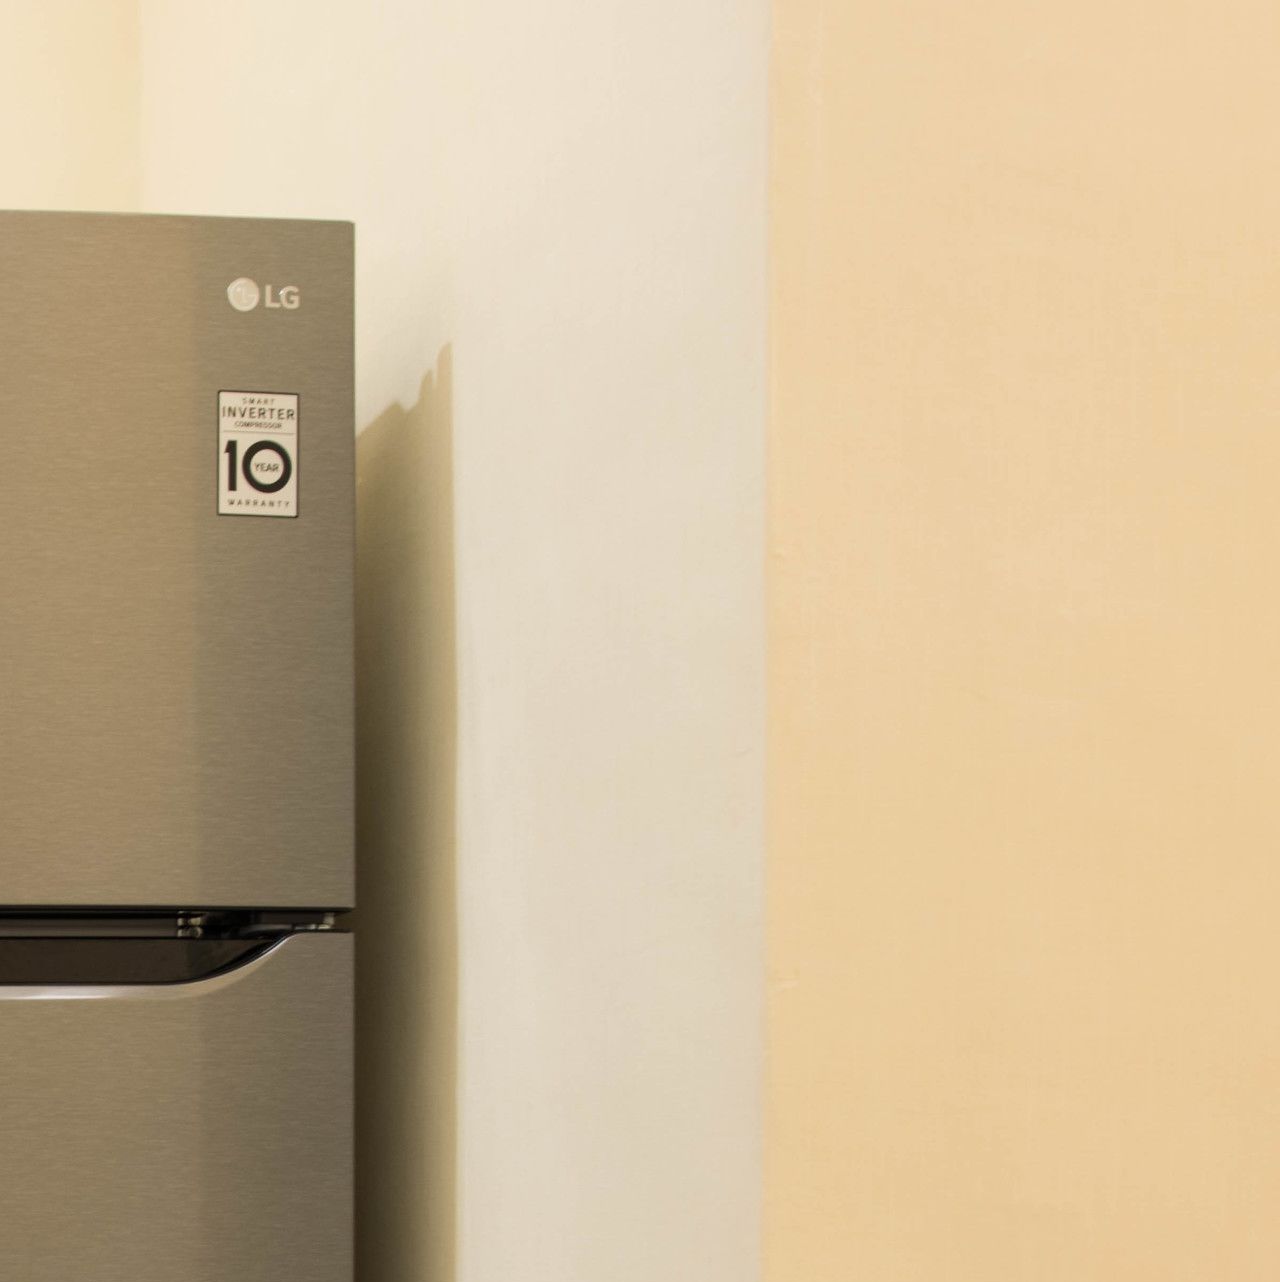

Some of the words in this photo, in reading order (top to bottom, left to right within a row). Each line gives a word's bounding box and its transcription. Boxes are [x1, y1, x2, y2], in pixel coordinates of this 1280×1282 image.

[264, 284, 300, 310] LG
[221, 406, 295, 421] INVERTER
[234, 420, 283, 429] COMPRESSOR
[224, 439, 293, 494] 10
[254, 462, 280, 472] YEAR
[228, 499, 290, 508] WARRANTY
